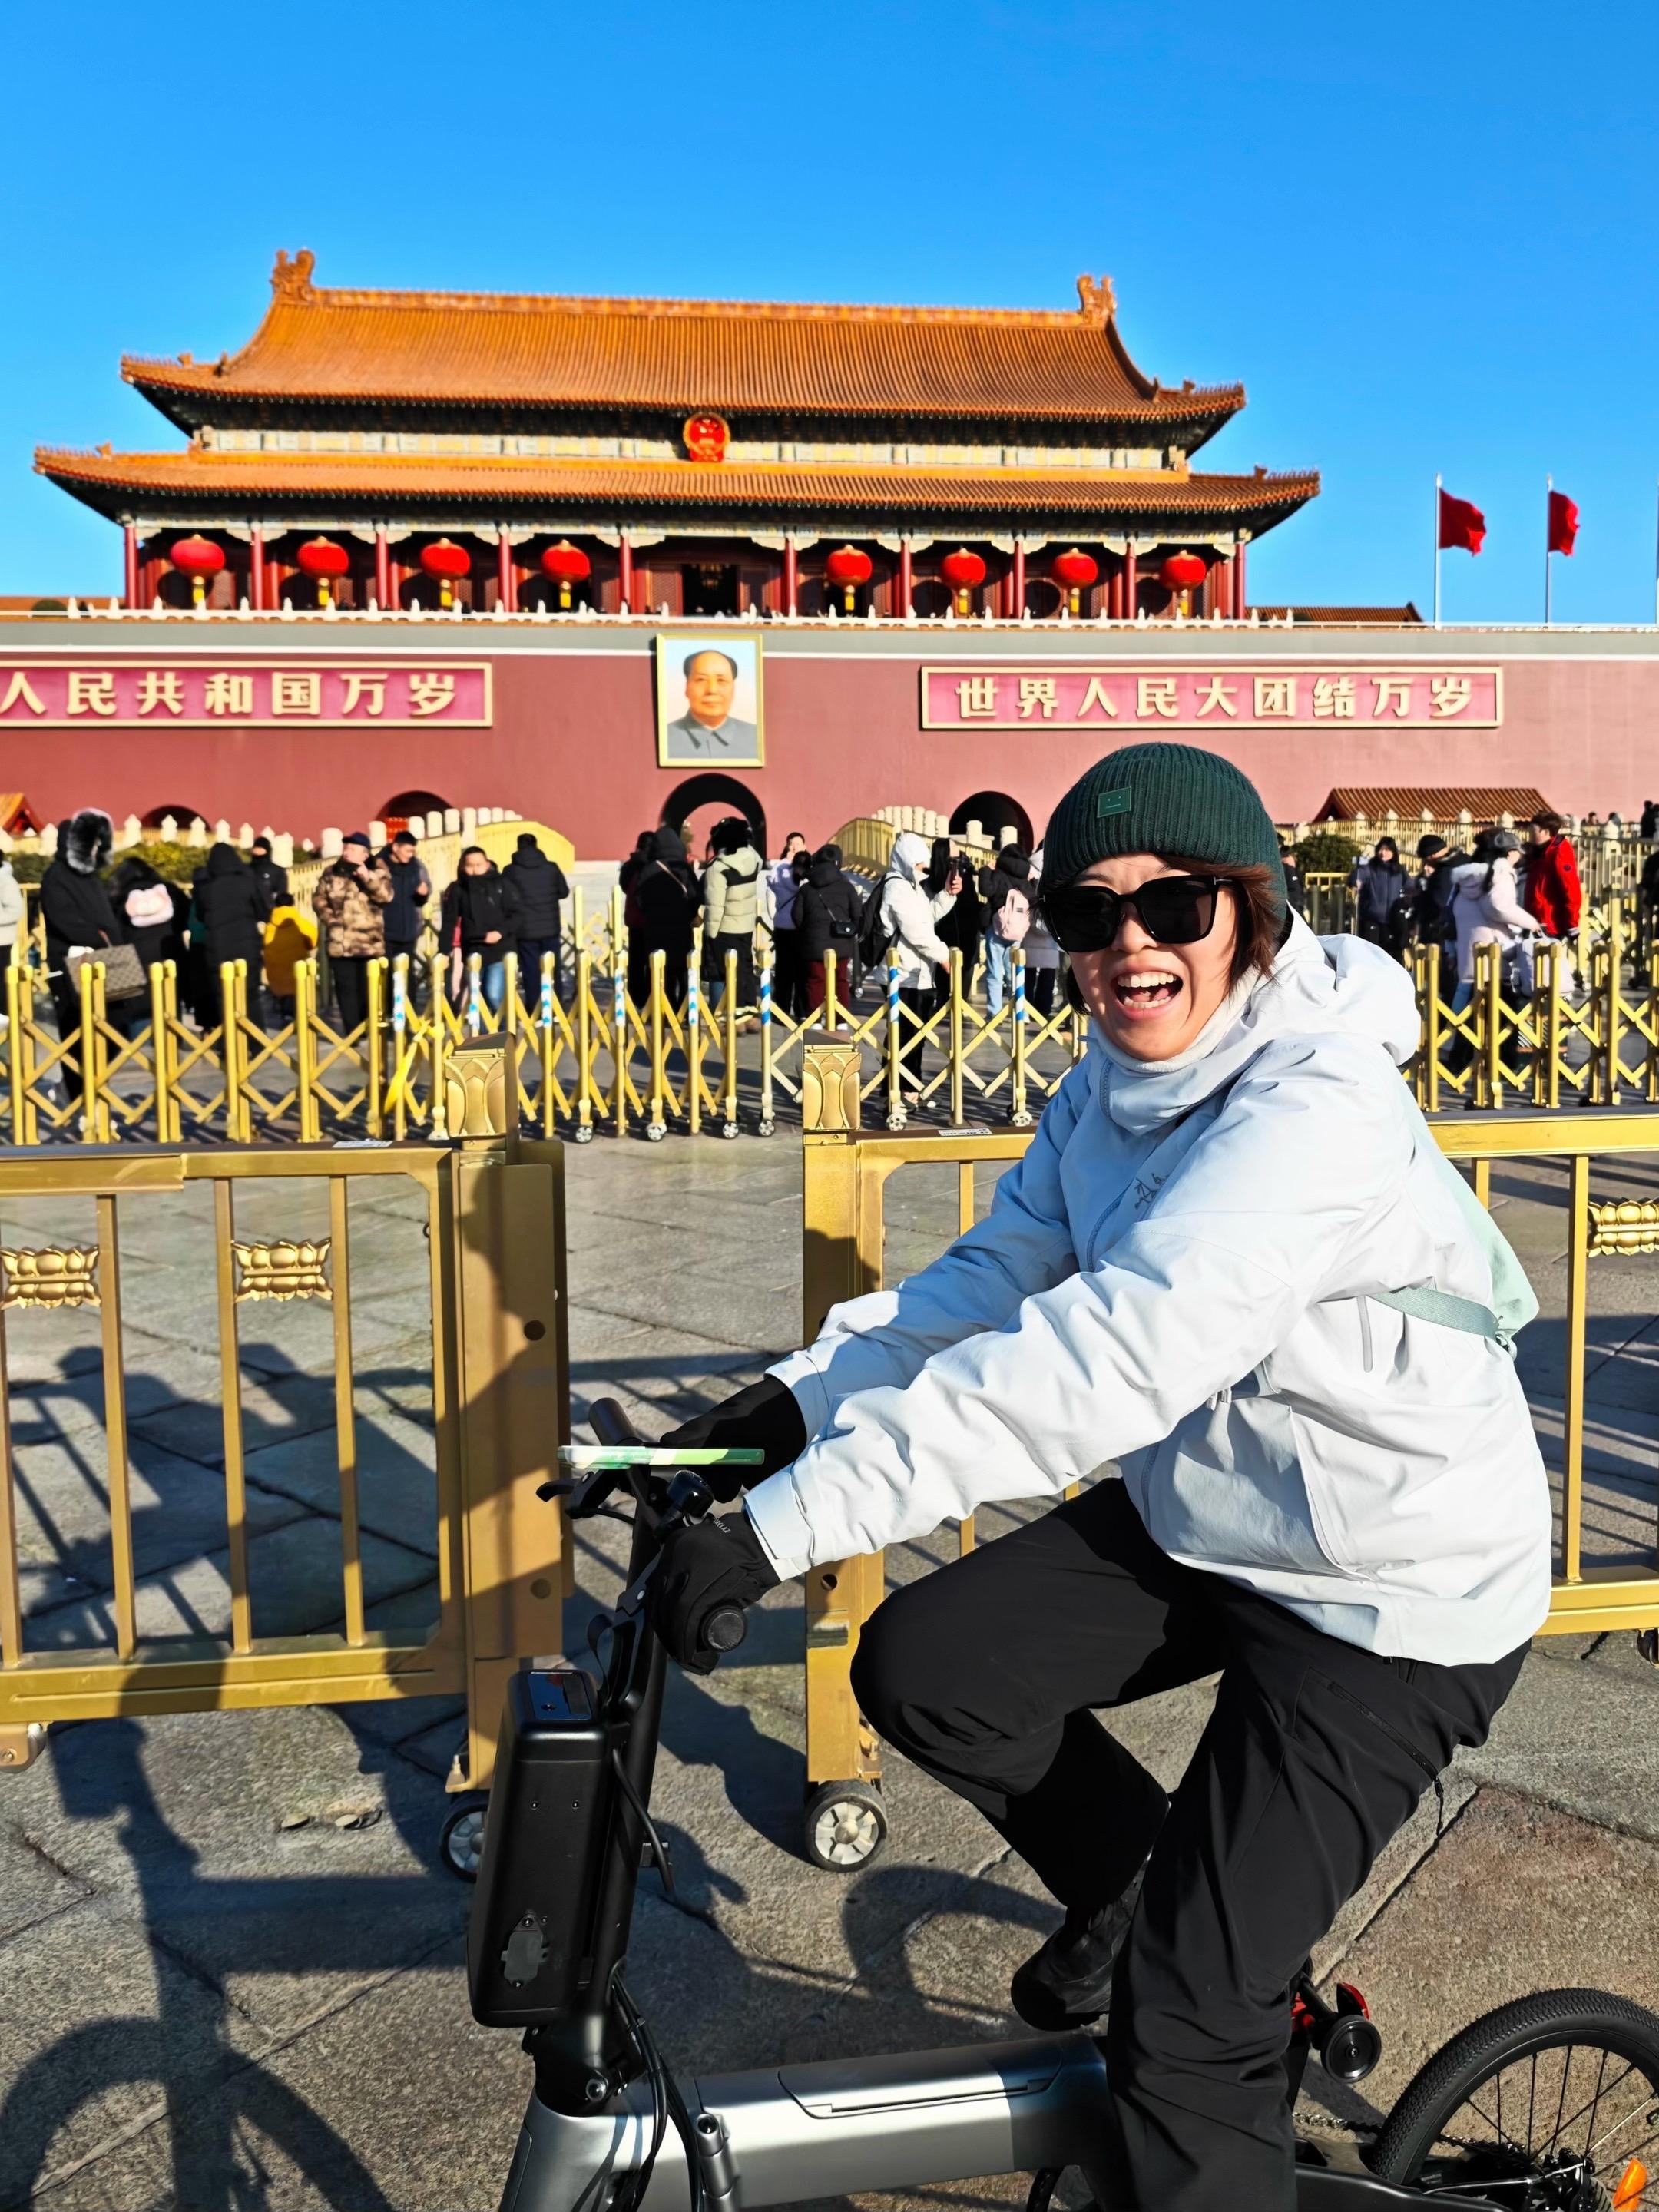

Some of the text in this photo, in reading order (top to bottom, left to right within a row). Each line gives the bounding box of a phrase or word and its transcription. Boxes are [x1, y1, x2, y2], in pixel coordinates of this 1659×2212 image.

[0, 671, 455, 715] 人民共和国万岁
[955, 677, 1472, 718] 世界人民大团结万岁
